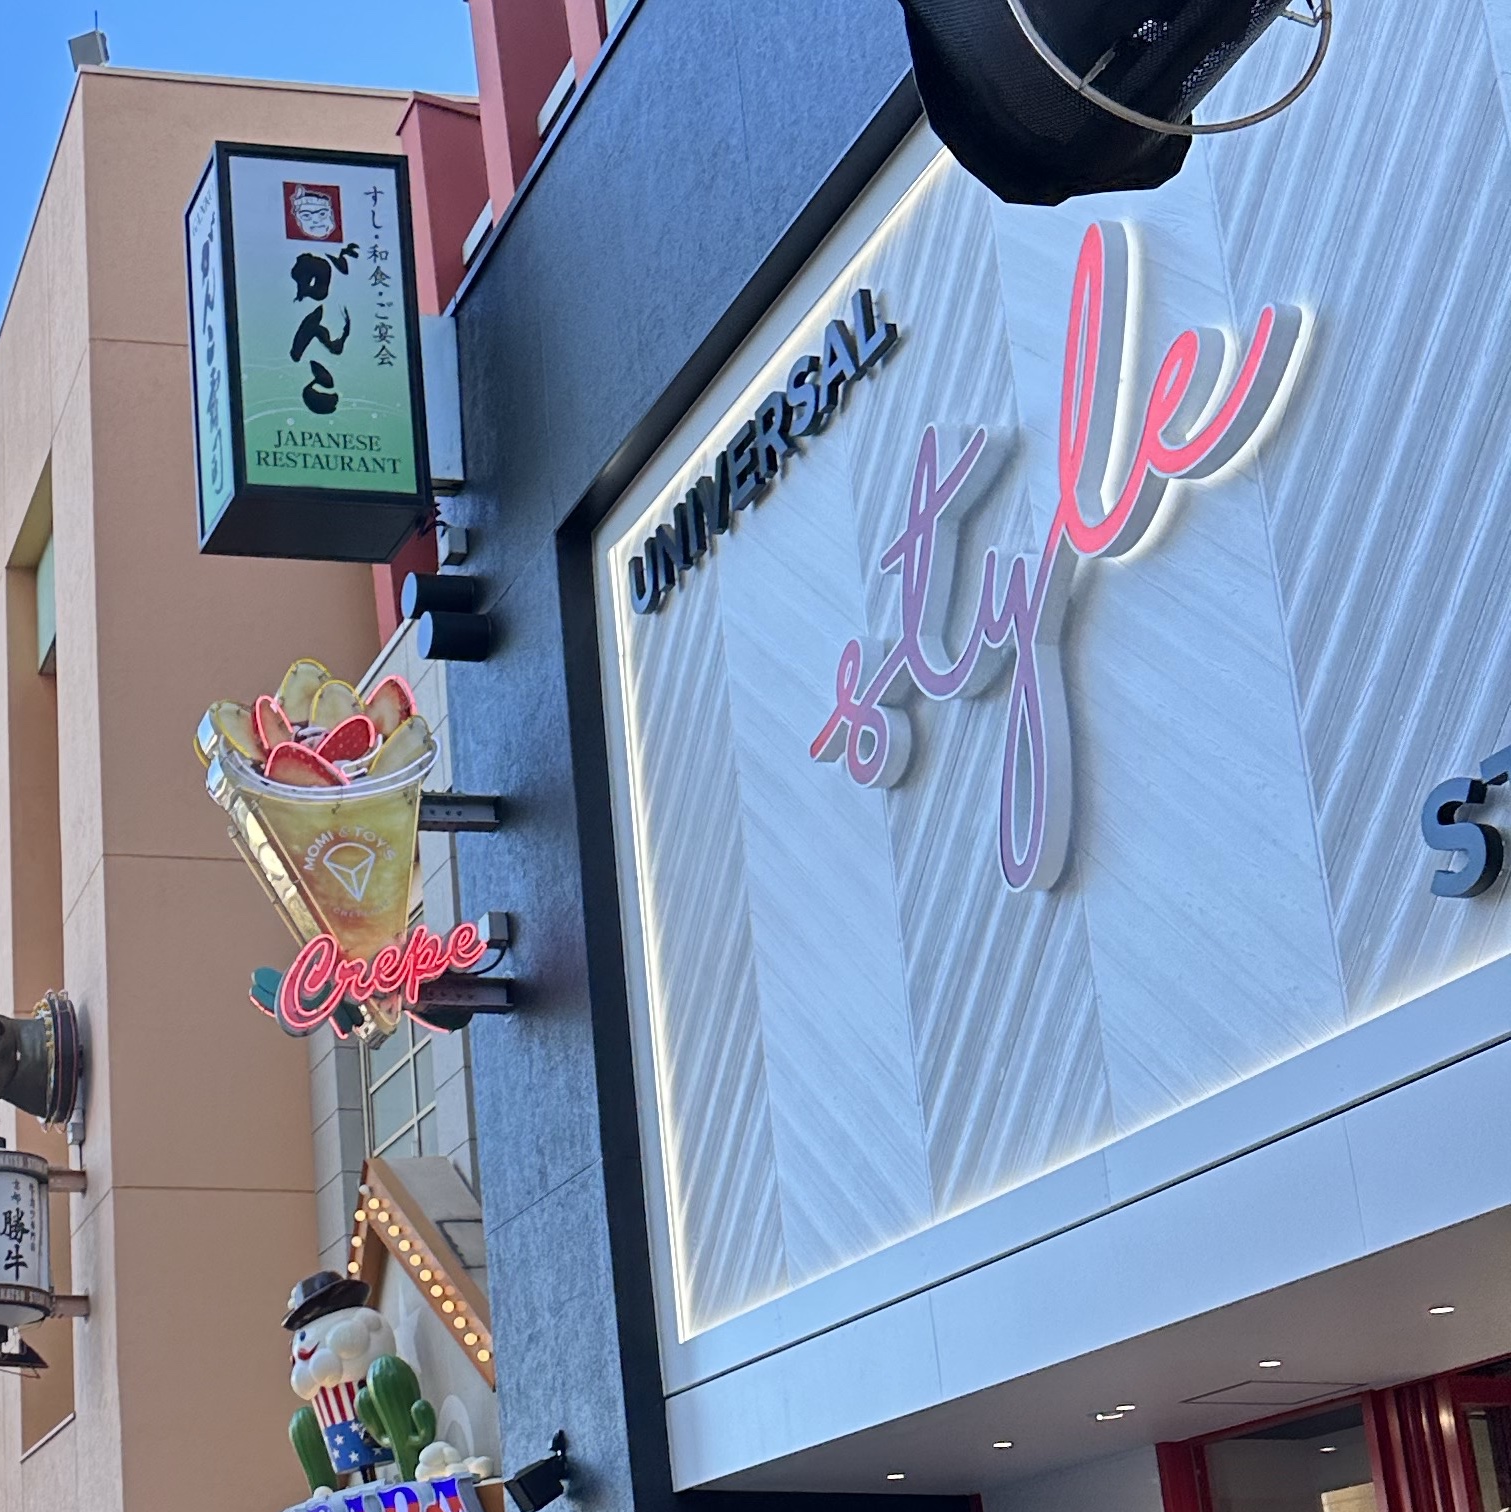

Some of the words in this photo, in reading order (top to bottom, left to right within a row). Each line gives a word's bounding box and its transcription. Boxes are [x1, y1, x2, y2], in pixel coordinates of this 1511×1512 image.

[291, 243, 360, 414] がんこ
[256, 450, 402, 475] RESTAURANT
[274, 430, 381, 452] JAPANESE
[628, 287, 899, 615] UNIVERSAL
[809, 220, 1293, 892] style
[303, 831, 334, 871] MOMI
[280, 922, 489, 1028] Crepe
[0, 1207, 30, 1281] 勝牛
